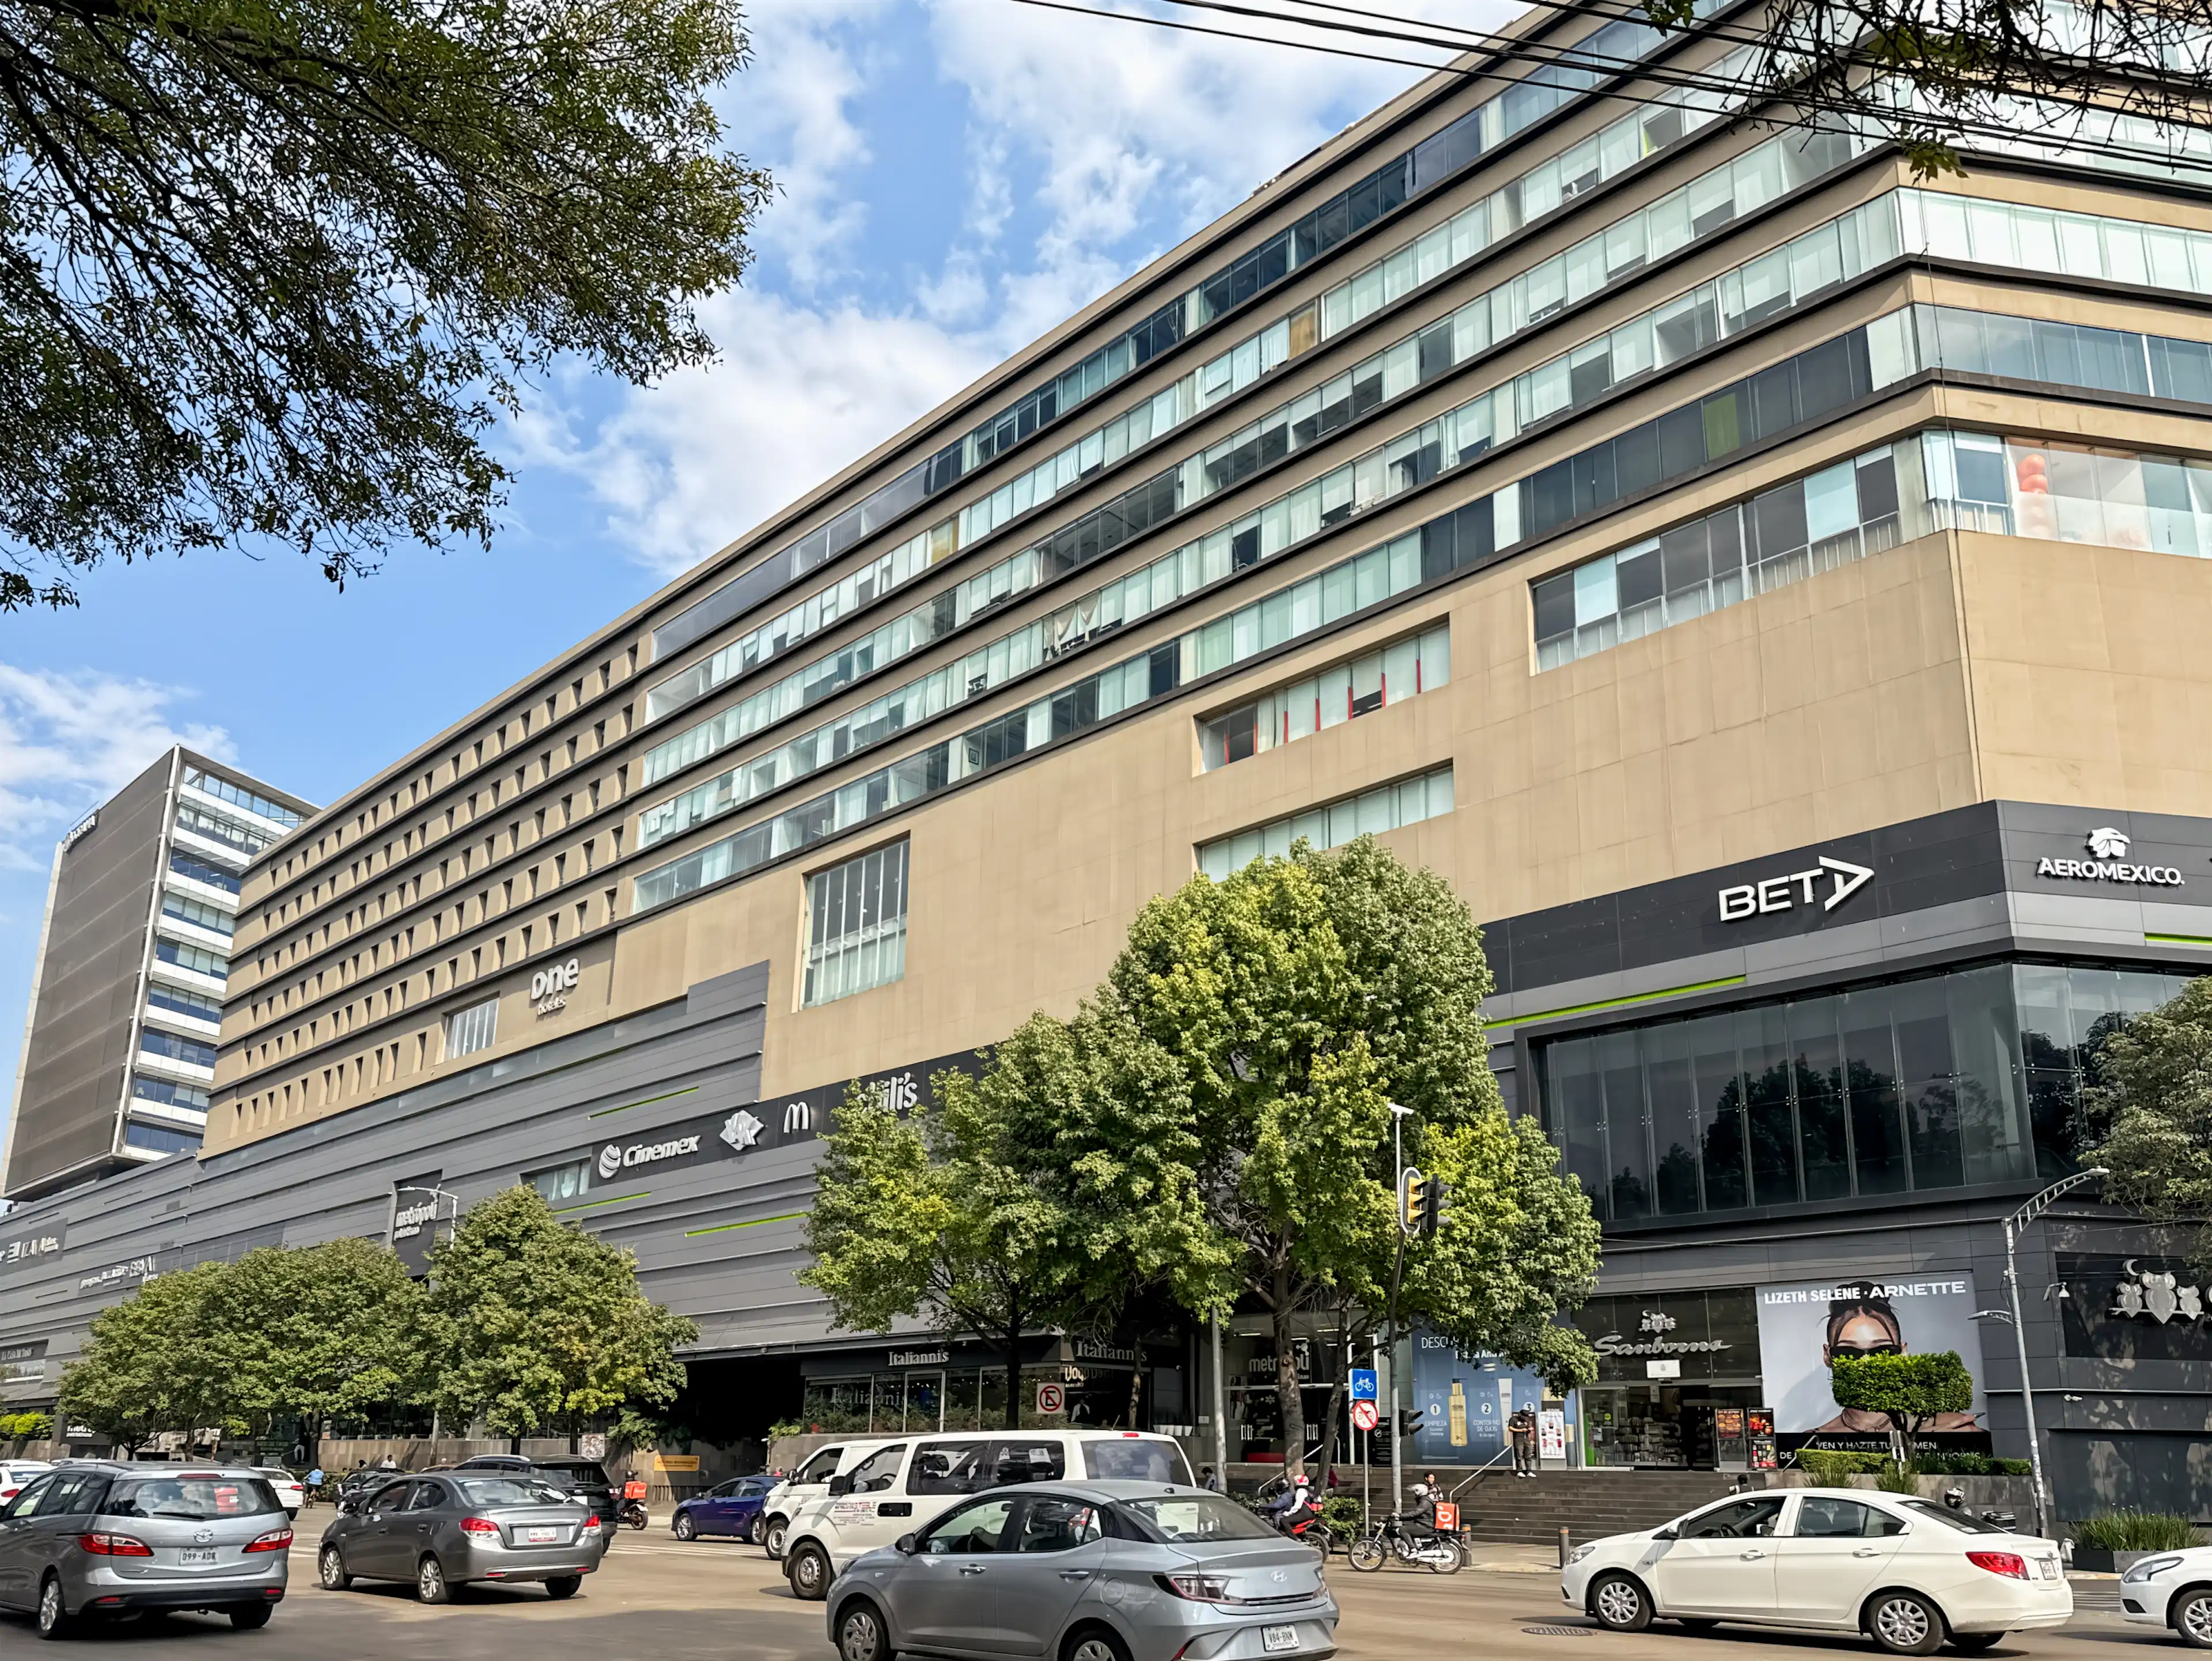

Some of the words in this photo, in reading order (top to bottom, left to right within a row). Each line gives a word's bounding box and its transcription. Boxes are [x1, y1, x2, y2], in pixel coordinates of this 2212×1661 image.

[531, 958, 579, 1000] one
[623, 1135, 702, 1167] Cinemex
[1764, 1291, 1808, 1304] LIZETH
[1810, 1286, 1861, 1302] SELENE
[1869, 1280, 1967, 1300] ARNETTE
[1076, 1340, 1147, 1362] Italianns
[1594, 1334, 1733, 1356] Sanborns
